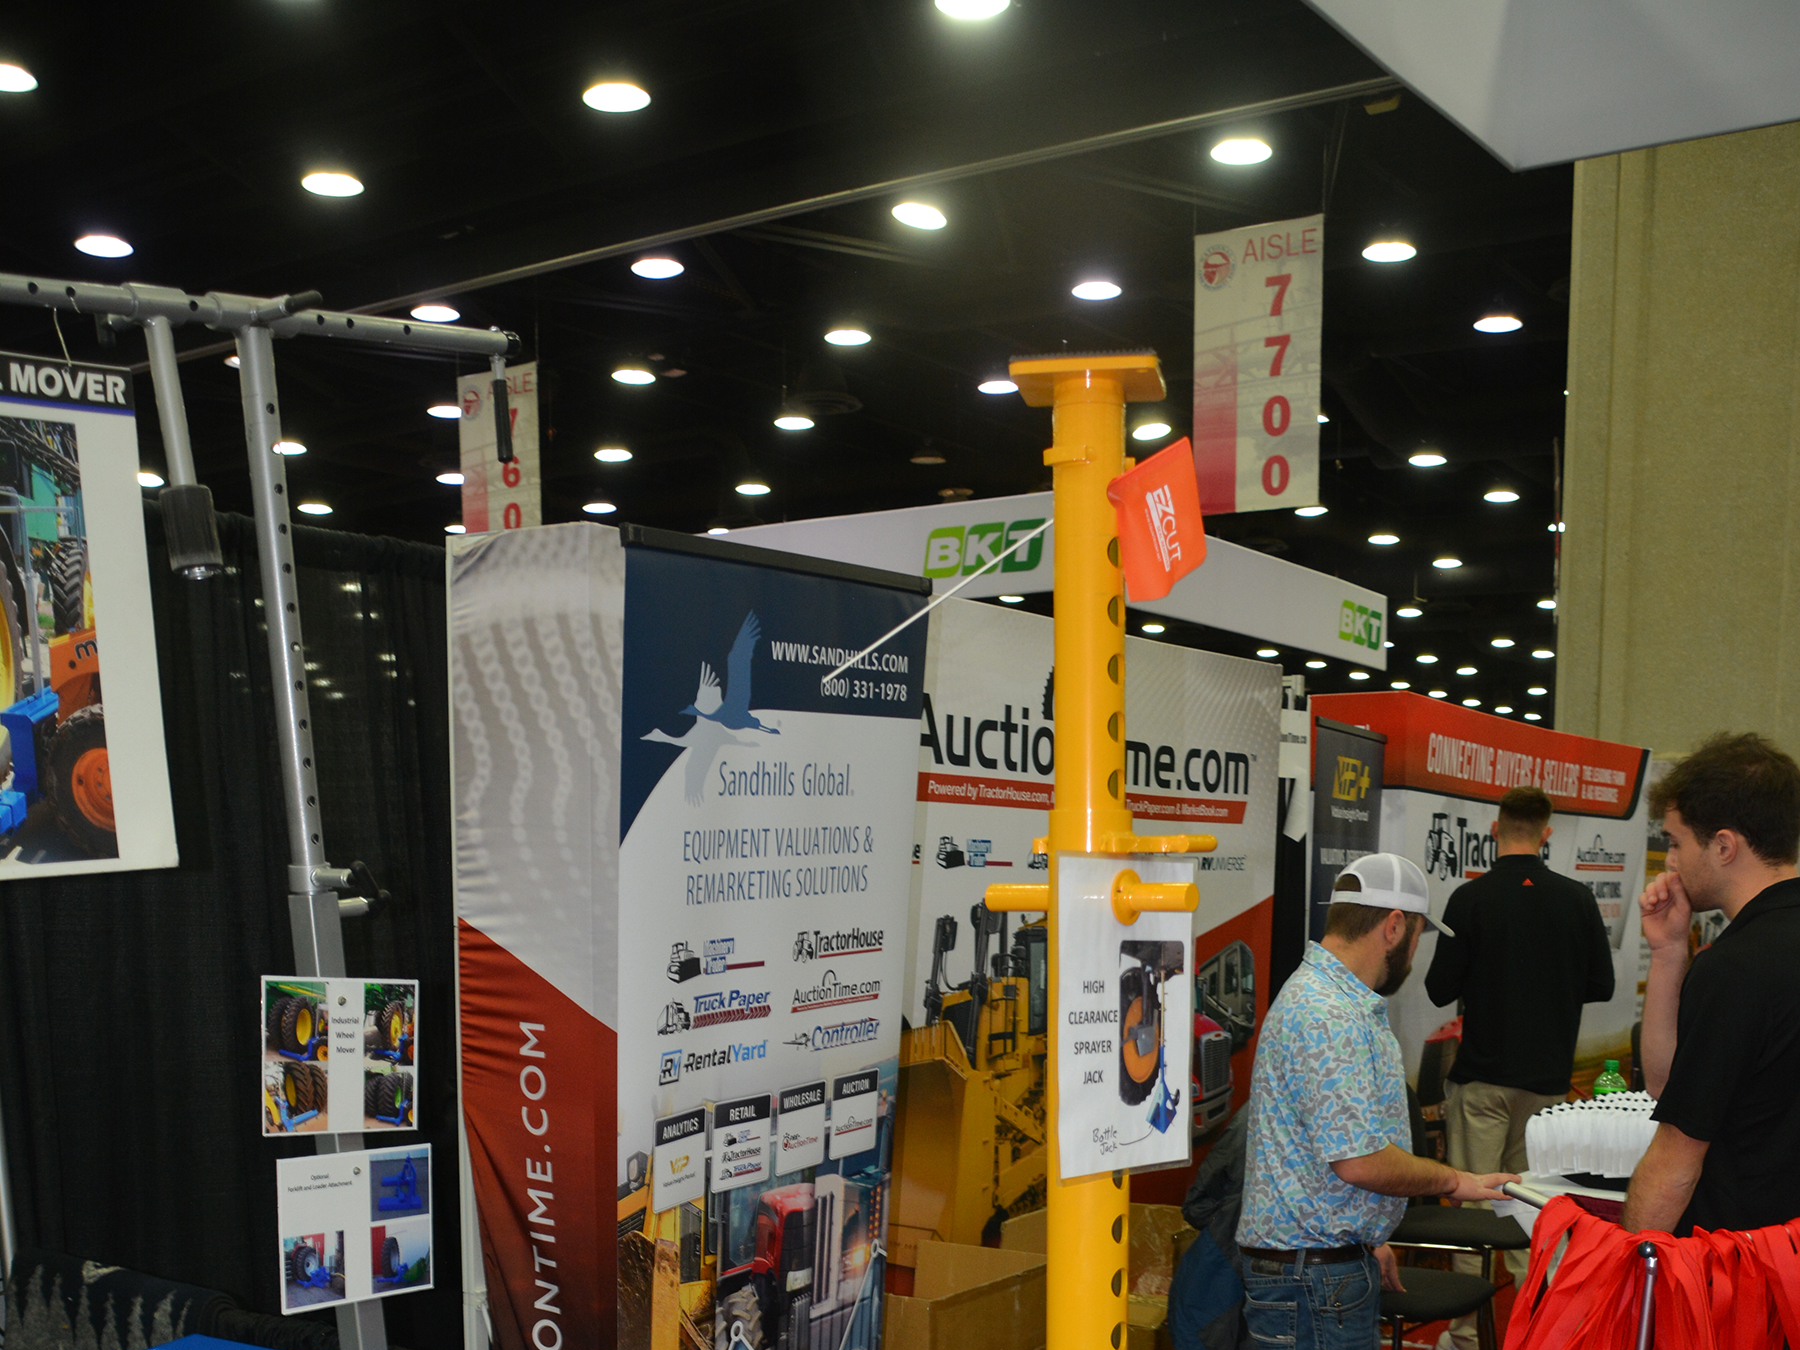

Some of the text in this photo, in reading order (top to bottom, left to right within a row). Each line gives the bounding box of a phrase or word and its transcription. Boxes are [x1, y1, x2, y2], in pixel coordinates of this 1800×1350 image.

[1242, 228, 1317, 263] AISLE
[9, 362, 127, 405] MOVER
[923, 520, 1046, 577] BKT
[1339, 600, 1382, 651] BKT
[771, 640, 909, 675] WWW.SANDHILLS.COM
[820, 676, 908, 702] (800) 331-1978
[1427, 732, 1495, 784] CONNECTING
[718, 761, 796, 797] Sandhills
[928, 779, 967, 798] Powered
[967, 783, 978, 800] by
[683, 827, 771, 864] EQUIPMENT
[775, 826, 860, 858] VALUATIONS
[863, 825, 874, 853] &
[686, 864, 869, 906] REMARKETING SOLUTIONS
[813, 928, 884, 959] TractorHouse
[792, 979, 881, 1005] AuctionTime.com
[1082, 980, 1105, 995] HIGH
[331, 1016, 360, 1025] Industrial
[1068, 1009, 1119, 1026] CLEARANCE
[335, 1031, 355, 1039] Wheel
[811, 1018, 880, 1050] Controller
[336, 1046, 356, 1054] Mover
[683, 1039, 767, 1073] RentalYard
[1073, 1040, 1112, 1055] SPRAYER
[842, 1078, 871, 1095] AUCTION
[1083, 1070, 1104, 1085] JACK
[783, 1089, 822, 1110] WHOLESALE
[729, 1105, 757, 1122] RETAIL
[662, 1116, 700, 1140] ANALYTICS
[1092, 1125, 1118, 1143] Bottle
[1099, 1140, 1118, 1156] Jack
